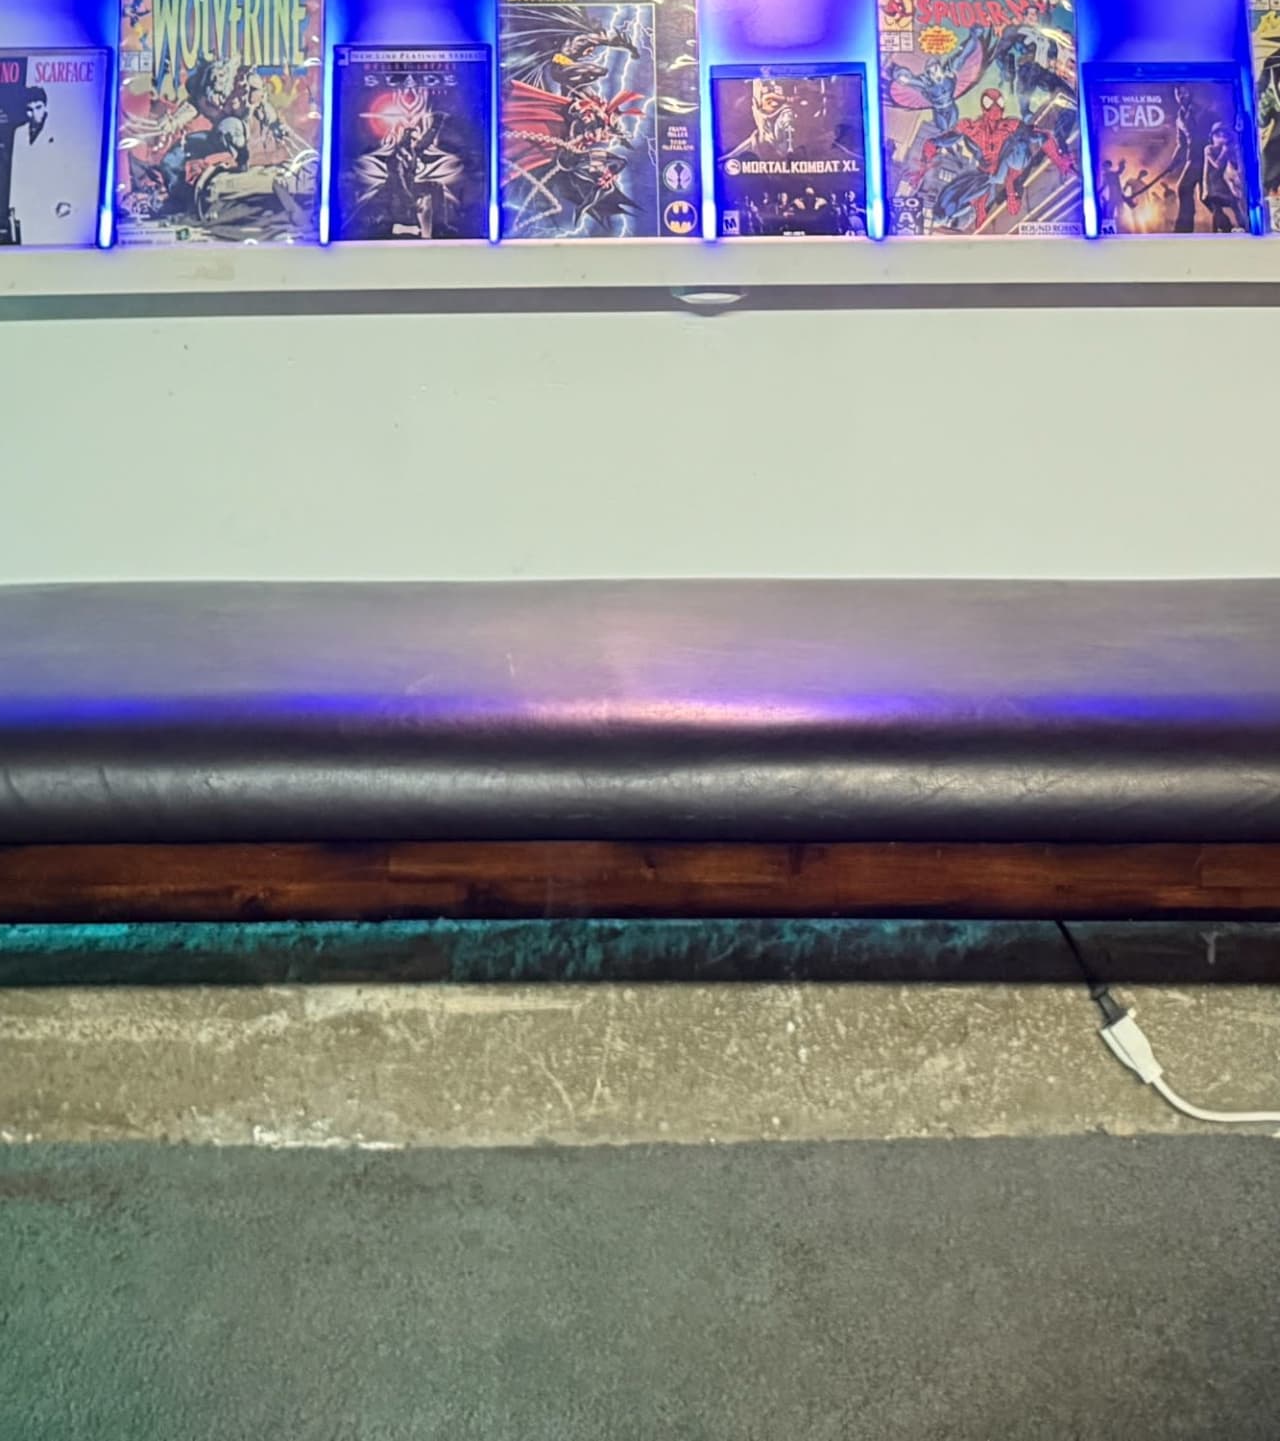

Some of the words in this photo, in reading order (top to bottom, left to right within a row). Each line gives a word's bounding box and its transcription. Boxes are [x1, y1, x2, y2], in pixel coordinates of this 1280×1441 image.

[34, 62, 95, 83] SCARFACE
[1100, 95, 1120, 103] THE
[1122, 95, 1162, 104] WALKING
[1102, 105, 1165, 127] DEAD
[742, 160, 790, 173] MORTAL
[791, 160, 841, 173] KOMBAT
[842, 159, 859, 172] XL
[892, 197, 919, 208] 50
